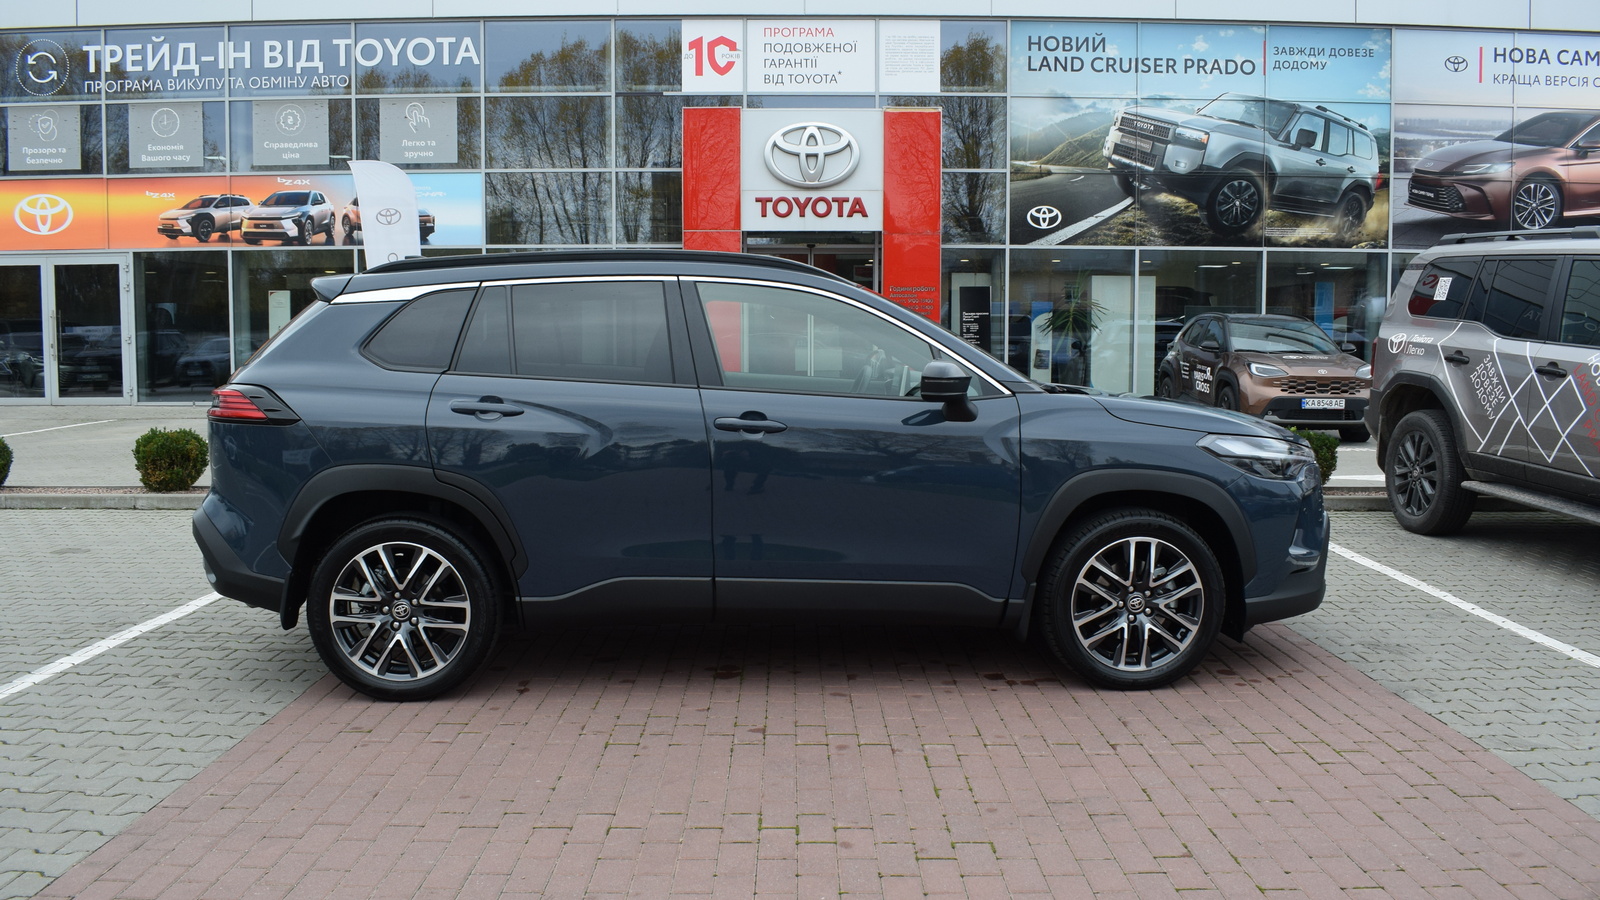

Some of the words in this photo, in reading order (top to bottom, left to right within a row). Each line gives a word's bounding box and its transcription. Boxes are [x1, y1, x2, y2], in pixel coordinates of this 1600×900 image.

[763, 27, 835, 38] ПРОГРАМА
[763, 40, 858, 55] ПОДОВЖЕНОЇ
[1027, 32, 1107, 53] НОВИЙ
[83, 36, 250, 77] ТРЕЙД-ІН
[264, 39, 323, 74] ВІД
[333, 37, 480, 67] TOYOTA
[1272, 46, 1326, 59] ЗАВЖДИ
[1328, 47, 1375, 59] ДОВЕЗЕ
[1493, 47, 1551, 65] НОВА
[763, 56, 819, 69] ГАРАНТІЇ
[1027, 55, 1085, 72] LAND
[1090, 56, 1178, 74] CRUISER
[1183, 58, 1257, 76] PRADO
[1272, 60, 1328, 71] ДОДОМУ
[84, 79, 163, 93] ПРОГРАМА
[168, 77, 225, 91] ВИКУПУ
[229, 77, 245, 89] ТА
[249, 75, 309, 89] ОБМІНУ
[310, 74, 349, 88] АВТО
[763, 73, 785, 86] ВІД
[1493, 73, 1541, 87] КРАЩА
[1545, 75, 1589, 88] ВЕРСІЯ
[1133, 120, 1154, 131] TOYOTA
[147, 143, 184, 151] Економія
[263, 141, 318, 149] Справедлива
[401, 139, 426, 147] Легко
[22, 147, 57, 155] Прозоро
[282, 152, 300, 160] ціна
[404, 150, 434, 158] зручно
[172, 155, 191, 163] часу
[755, 196, 868, 218] TOYOTA
[912, 285, 936, 293] роботи
[1475, 363, 1499, 408] ДОВЕЗЕ
[1483, 354, 1506, 404] ЗАВЖДИ
[1573, 363, 1597, 407] LAND
[1195, 380, 1210, 394] CROSS
[1469, 371, 1496, 420] ДОДОМУ
[1305, 399, 1316, 407] KA
[1316, 399, 1333, 407] 8548
[1333, 399, 1344, 408] AE
